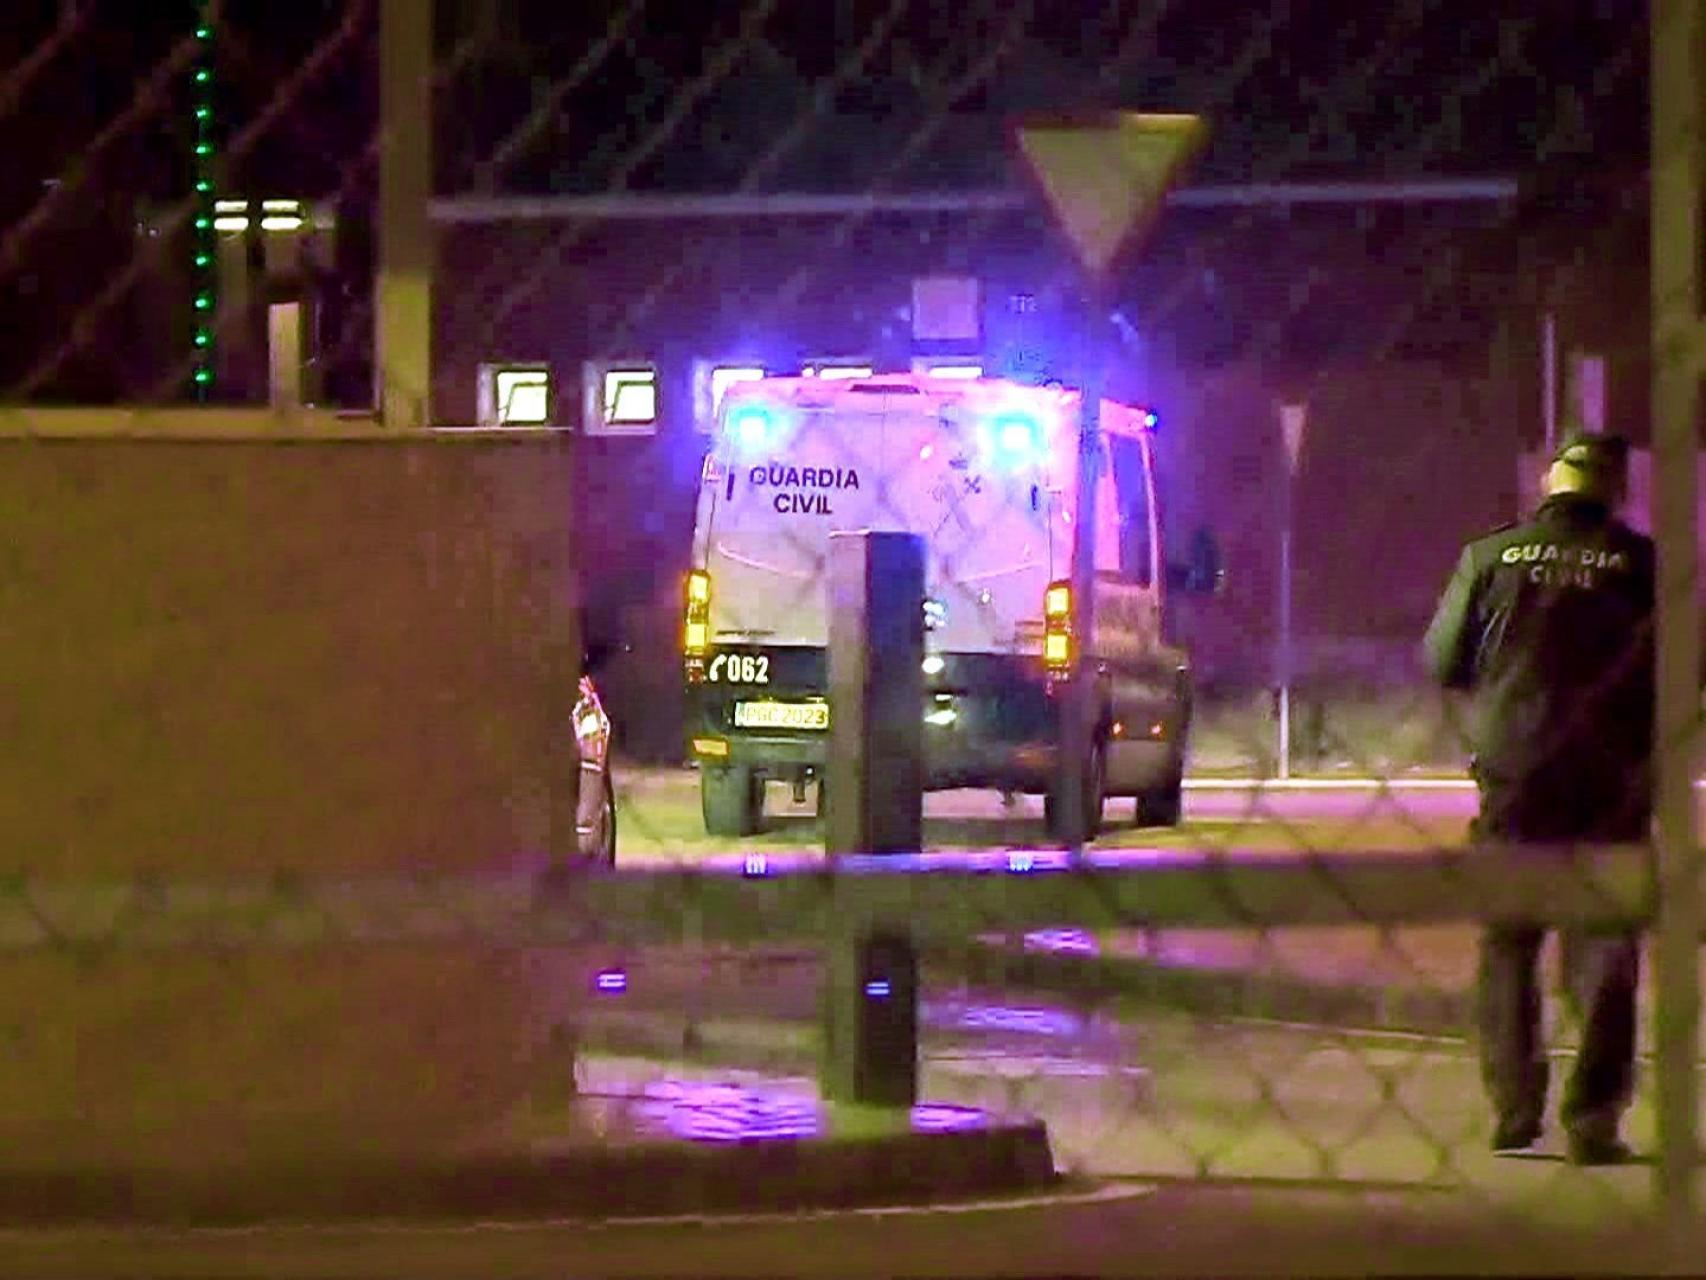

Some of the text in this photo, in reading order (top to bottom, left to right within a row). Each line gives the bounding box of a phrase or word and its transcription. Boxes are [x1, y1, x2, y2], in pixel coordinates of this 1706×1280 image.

[750, 466, 859, 489] GUARDIA
[774, 494, 832, 514] CIVIL
[1502, 545, 1624, 568] GUADIA
[727, 655, 769, 683] 062
